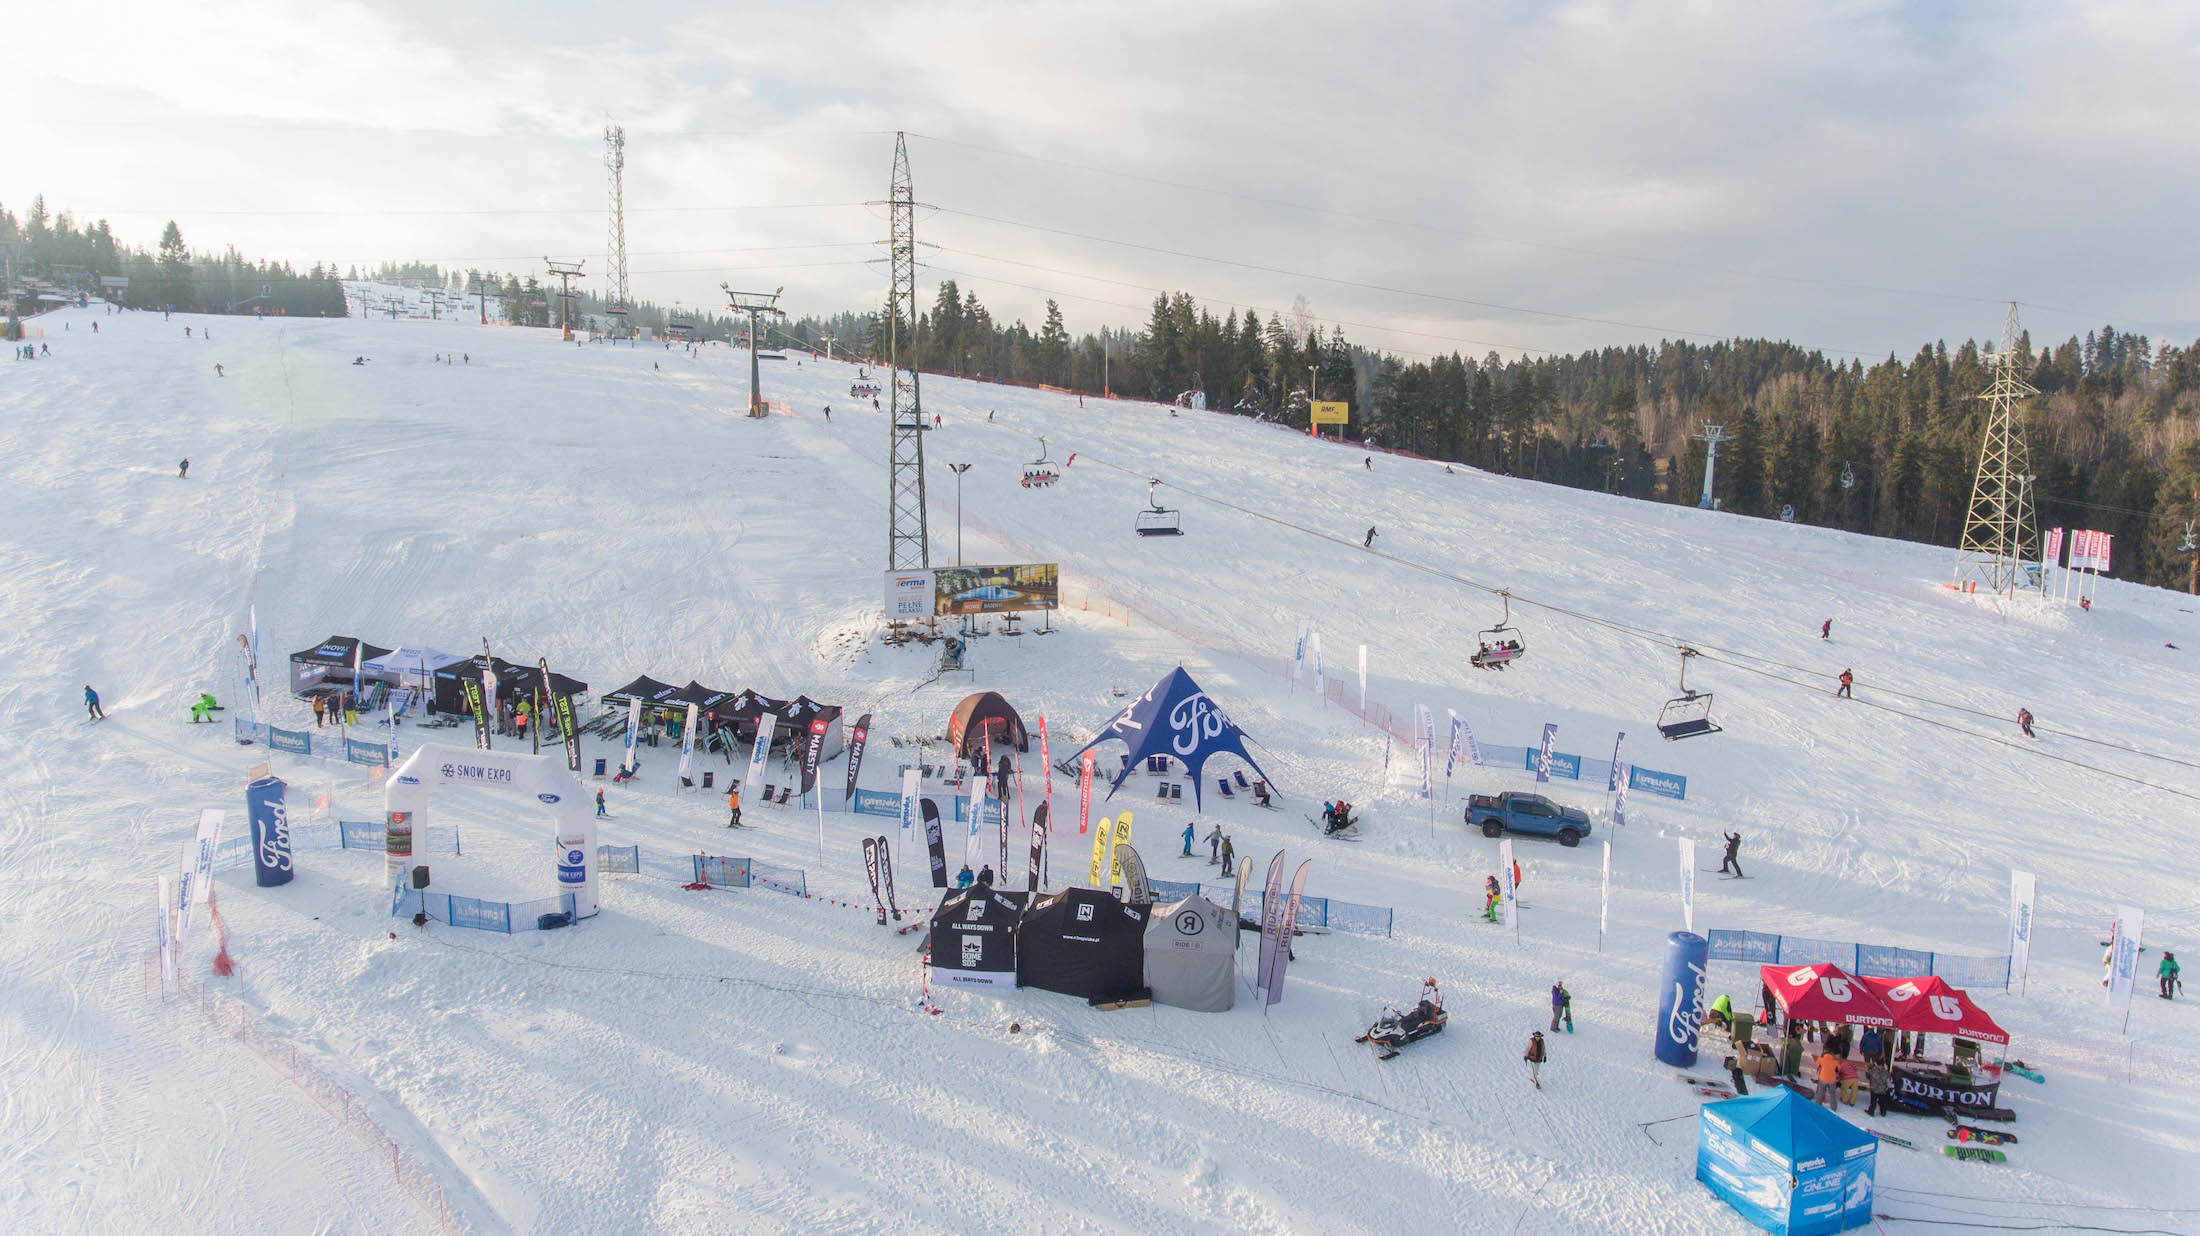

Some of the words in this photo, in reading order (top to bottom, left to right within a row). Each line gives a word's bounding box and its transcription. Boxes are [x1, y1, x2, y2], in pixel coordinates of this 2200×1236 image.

[896, 576, 925, 587] Terma
[653, 687, 677, 700] elan
[704, 692, 726, 705] elan
[1170, 691, 1234, 755] For
[807, 734, 821, 775] MAJESTY
[848, 742, 862, 783] MAJESTY
[1539, 730, 1557, 777] Ford
[457, 764, 485, 778] SNOW
[487, 768, 511, 781] EXPO
[257, 798, 292, 871] Ford
[1267, 904, 1278, 936] RIDE
[1280, 921, 1292, 947] RIDE
[962, 952, 982, 960] ROME
[1669, 961, 1707, 1053] Ford
[1846, 1014, 1885, 1026] BURTON
[1959, 1027, 1997, 1042] BURTON
[1901, 1077, 1992, 1106] BURTON
[1957, 1147, 1995, 1161] BURTON
[1804, 1178, 1841, 1192] ONLINE
